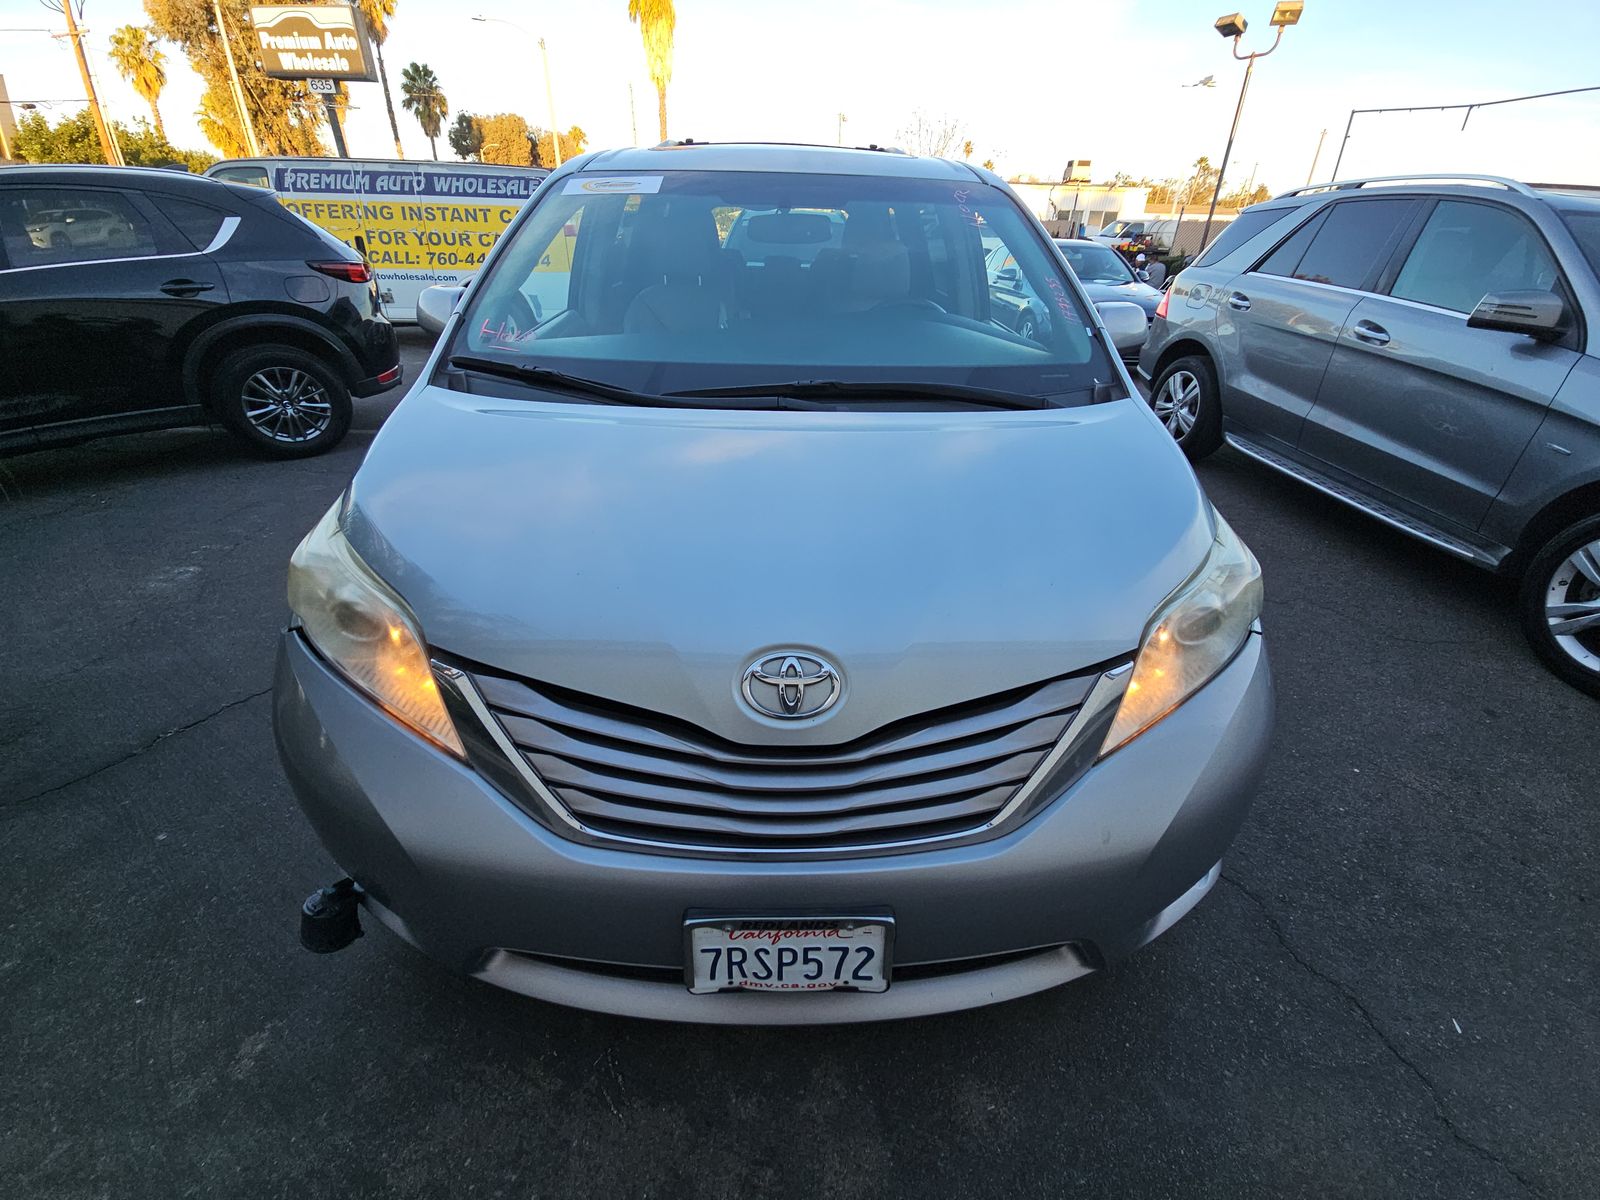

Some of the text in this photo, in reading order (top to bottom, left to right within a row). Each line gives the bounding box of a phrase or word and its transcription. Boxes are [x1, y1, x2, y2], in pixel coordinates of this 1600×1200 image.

[259, 31, 358, 50] Premium Auto
[278, 52, 349, 71] Wholesale
[310, 80, 333, 91] 635
[284, 172, 539, 196] PREMIUM AUTO WHOLESALE
[400, 206, 491, 223] INSTANT
[365, 230, 408, 245] FOR
[413, 231, 472, 247] YOUR
[368, 250, 420, 265] CALL:
[740, 920, 840, 930] REDLANDS
[700, 946, 875, 982] 7RSP572
[739, 980, 838, 989] dmv.ca.gov
